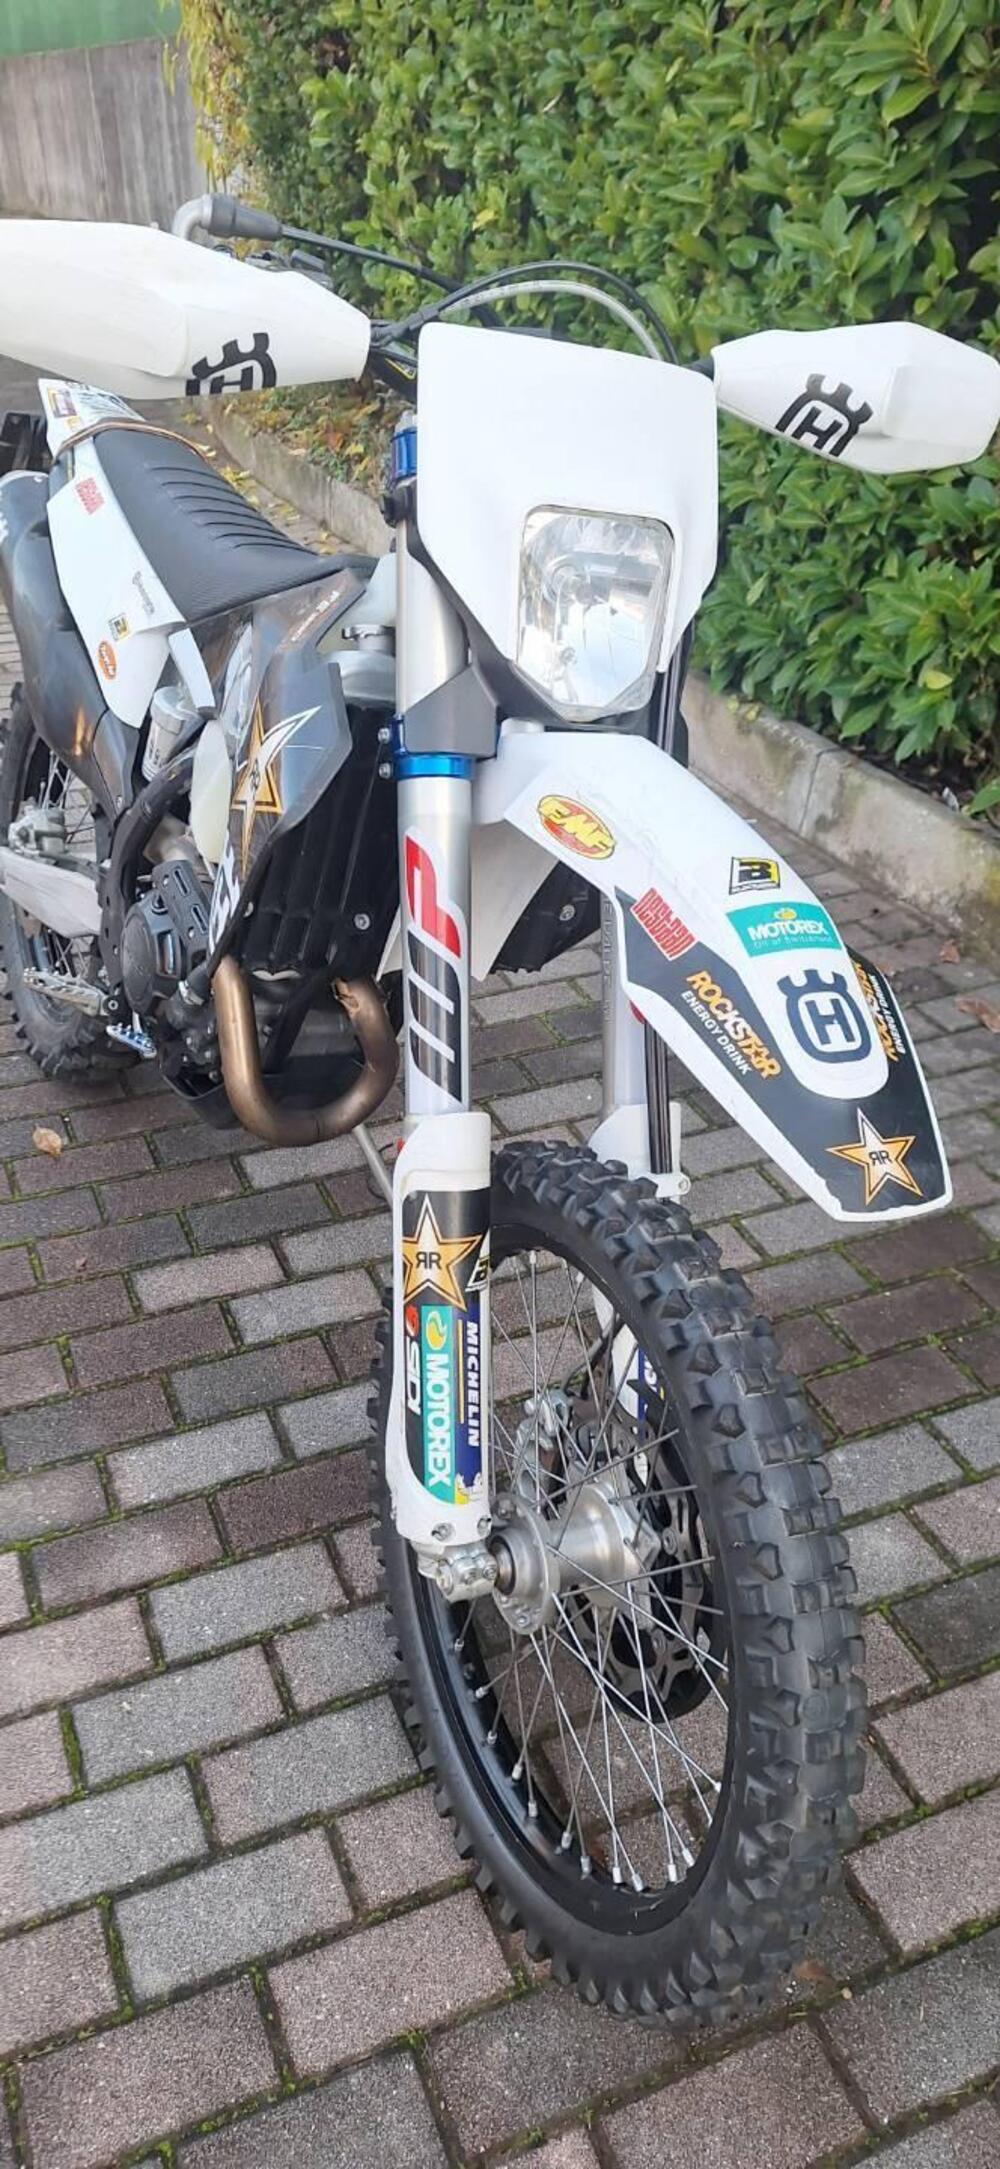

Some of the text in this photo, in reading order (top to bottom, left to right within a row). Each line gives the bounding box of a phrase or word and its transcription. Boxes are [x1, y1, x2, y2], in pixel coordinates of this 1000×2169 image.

[539, 796, 616, 853] FMF
[747, 920, 829, 941] MOTOREX
[681, 990, 752, 1075] ENERGY DRINK
[686, 970, 781, 1079] ROCKSTAR
[426, 1353, 452, 1487] MOTOREX
[466, 1321, 480, 1447] MICHELIN
